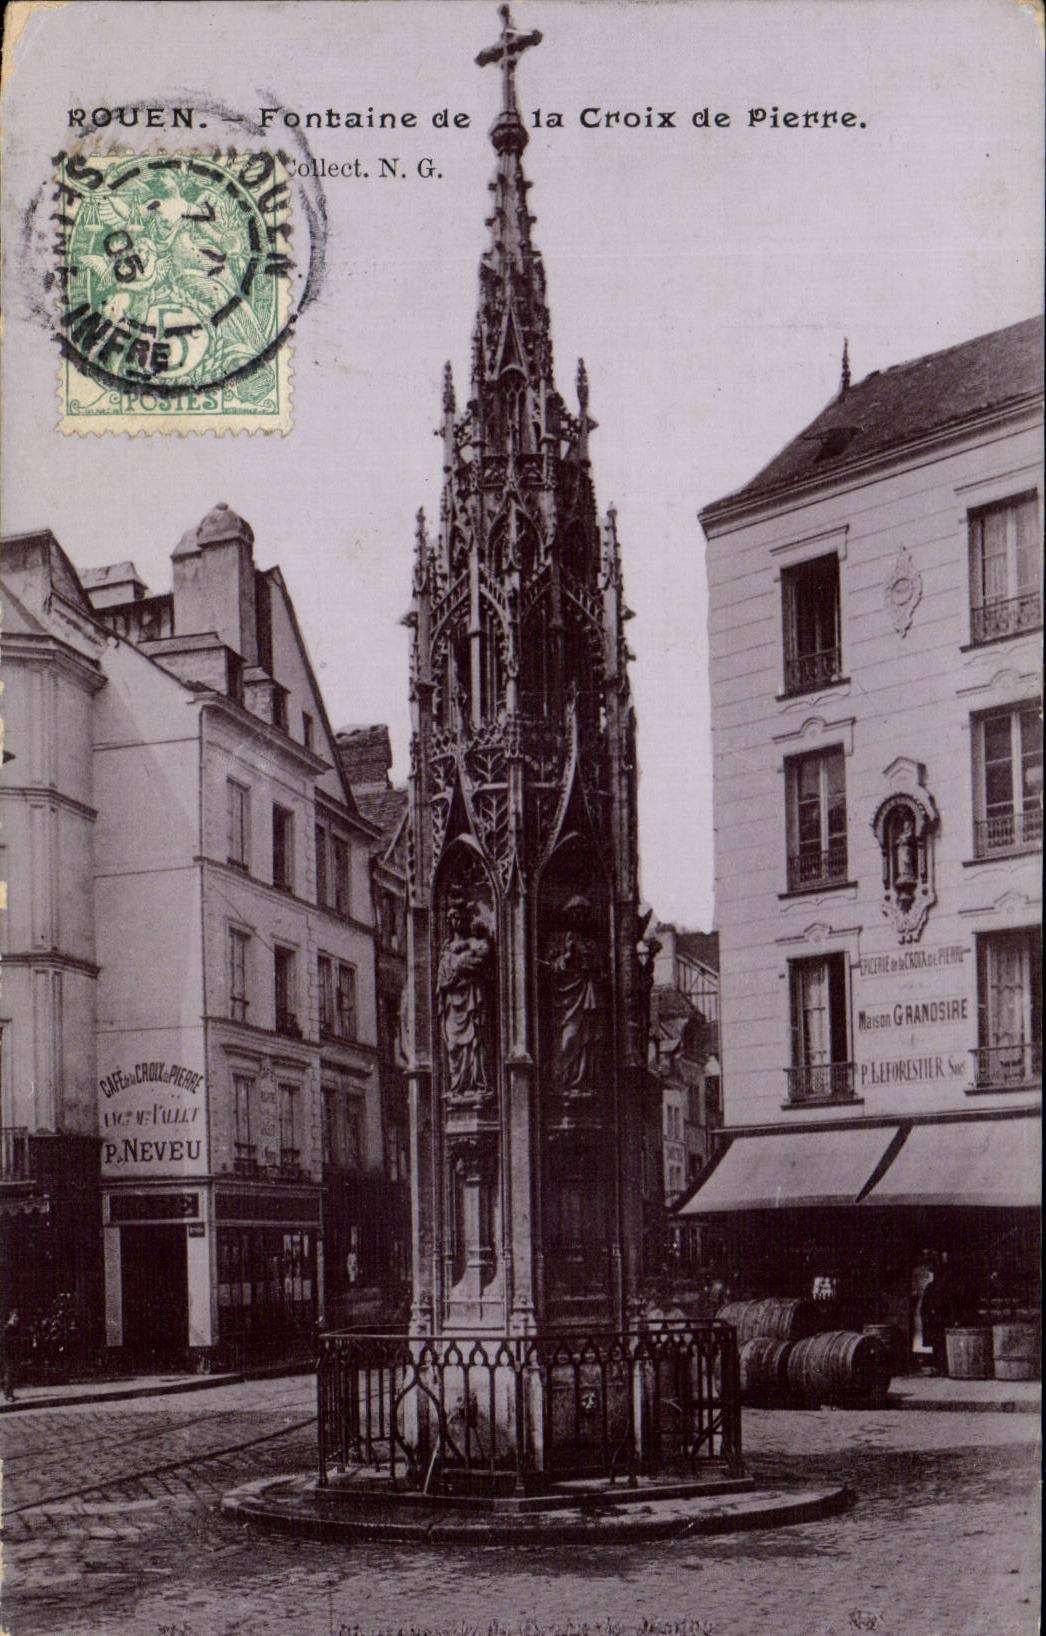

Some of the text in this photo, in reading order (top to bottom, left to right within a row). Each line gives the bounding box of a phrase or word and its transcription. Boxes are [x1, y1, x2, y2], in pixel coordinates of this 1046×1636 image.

[858, 998, 968, 1031] Maison GRANDSIRE
[135, 1062, 165, 1084] CROIX
[169, 1064, 205, 1095] PIERRE
[122, 1136, 202, 1163] NEVEU
